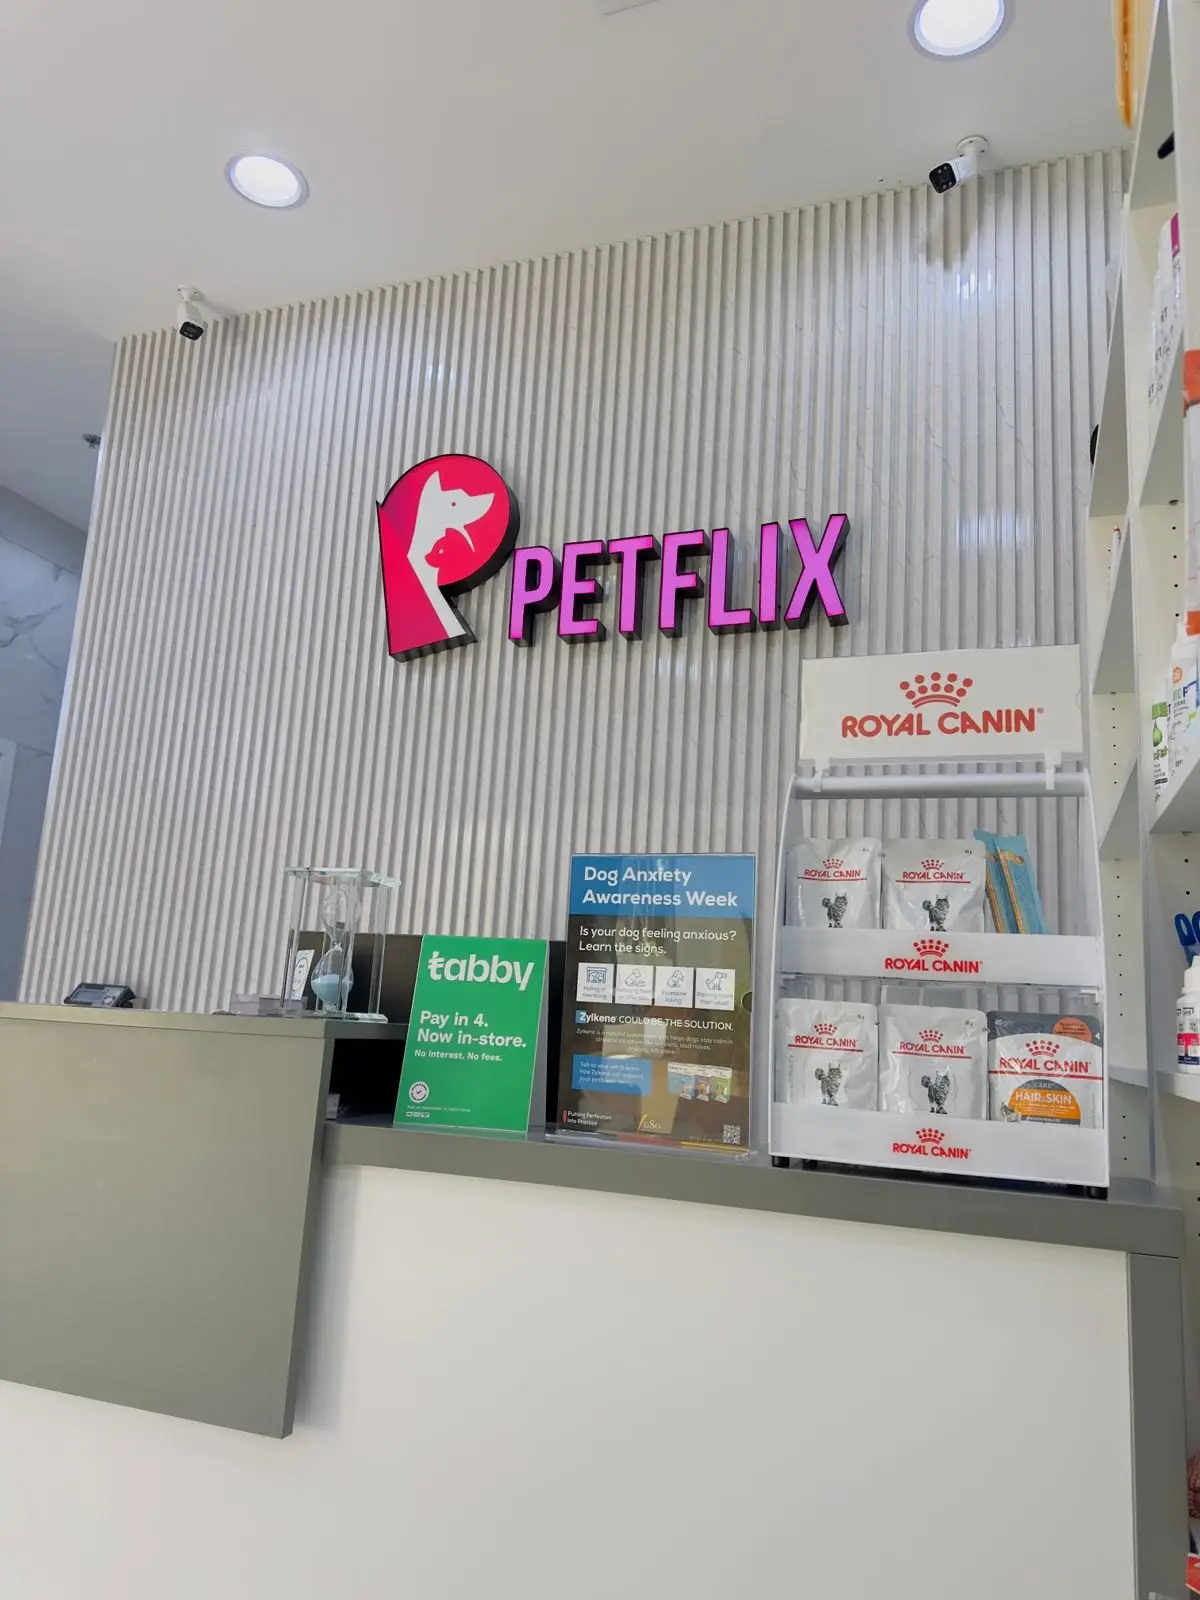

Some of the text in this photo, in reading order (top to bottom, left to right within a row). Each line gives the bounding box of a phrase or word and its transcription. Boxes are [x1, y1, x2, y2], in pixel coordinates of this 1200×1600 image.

[508, 513, 849, 645] PETFLIX
[841, 708, 1036, 739] ROYAL CANIN
[584, 866, 692, 886] Dog Anxiety
[804, 868, 861, 878] ROYAL CANIN
[902, 871, 964, 881] ROYAL CANIN
[582, 889, 739, 907] Awareness Week
[579, 926, 737, 943] Is your dog feeling anxious?
[579, 941, 667, 957] Learn the signs.
[427, 951, 535, 991] tabby
[885, 957, 980, 973] ROYAL CANIN
[419, 1010, 489, 1029] Pay in 4.
[579, 1012, 734, 1031] Zylkene COULD BE THE SOLUTION.
[417, 1028, 527, 1048] Now in-store.
[795, 1035, 857, 1048] ROYAL CANIN
[414, 1049, 426, 1057] No
[467, 1052, 480, 1060] No
[481, 1053, 503, 1062] fees.
[900, 1041, 964, 1055] ROYAL CANIN
[999, 1057, 1090, 1073] ROYAL CANIN
[1015, 1091, 1042, 1102] HAIR
[1045, 1093, 1072, 1105] SKIN
[892, 1142, 969, 1159] ROYAL CANIN
